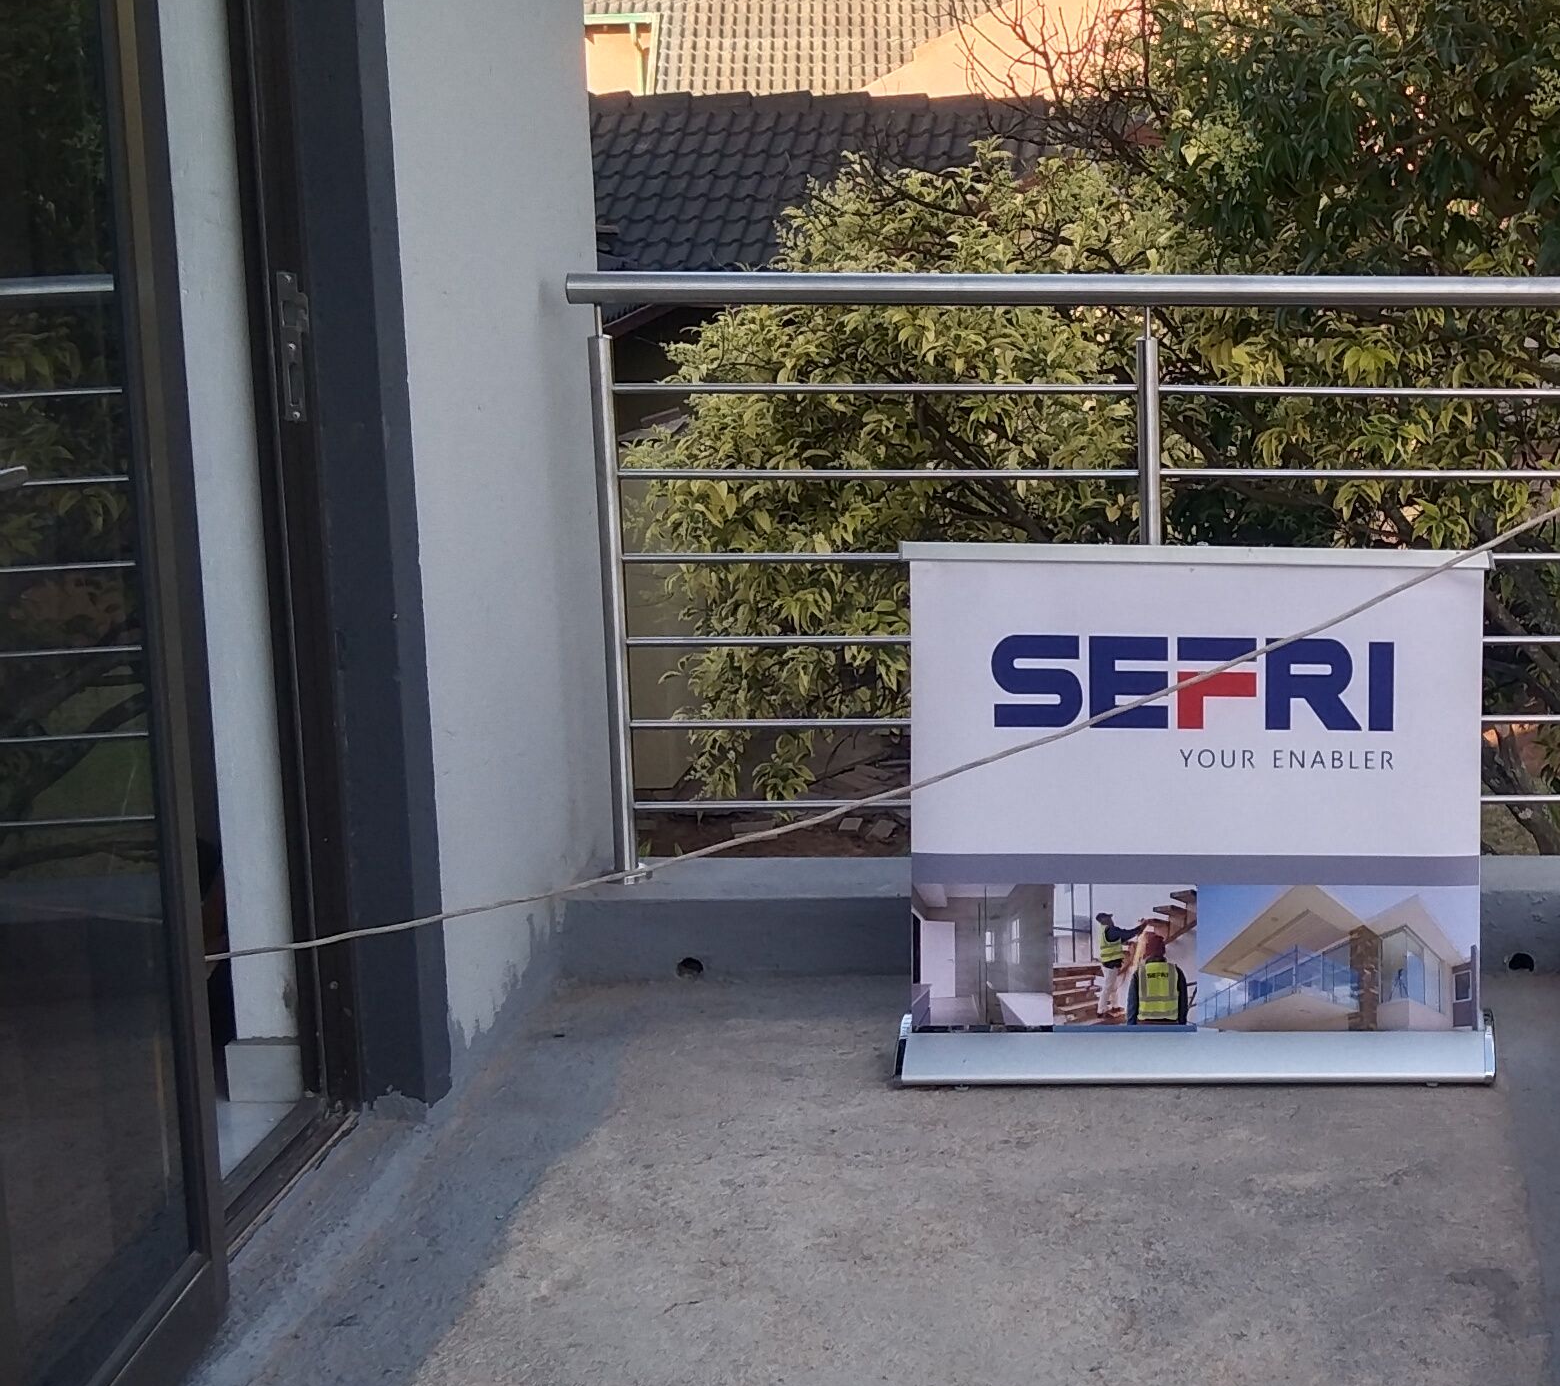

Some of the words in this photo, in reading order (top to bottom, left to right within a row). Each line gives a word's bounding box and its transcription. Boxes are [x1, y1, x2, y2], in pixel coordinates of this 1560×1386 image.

[991, 634, 1394, 732] SEFRI
[1180, 748, 1255, 770] YOUR
[1273, 748, 1394, 771] ENABLER
